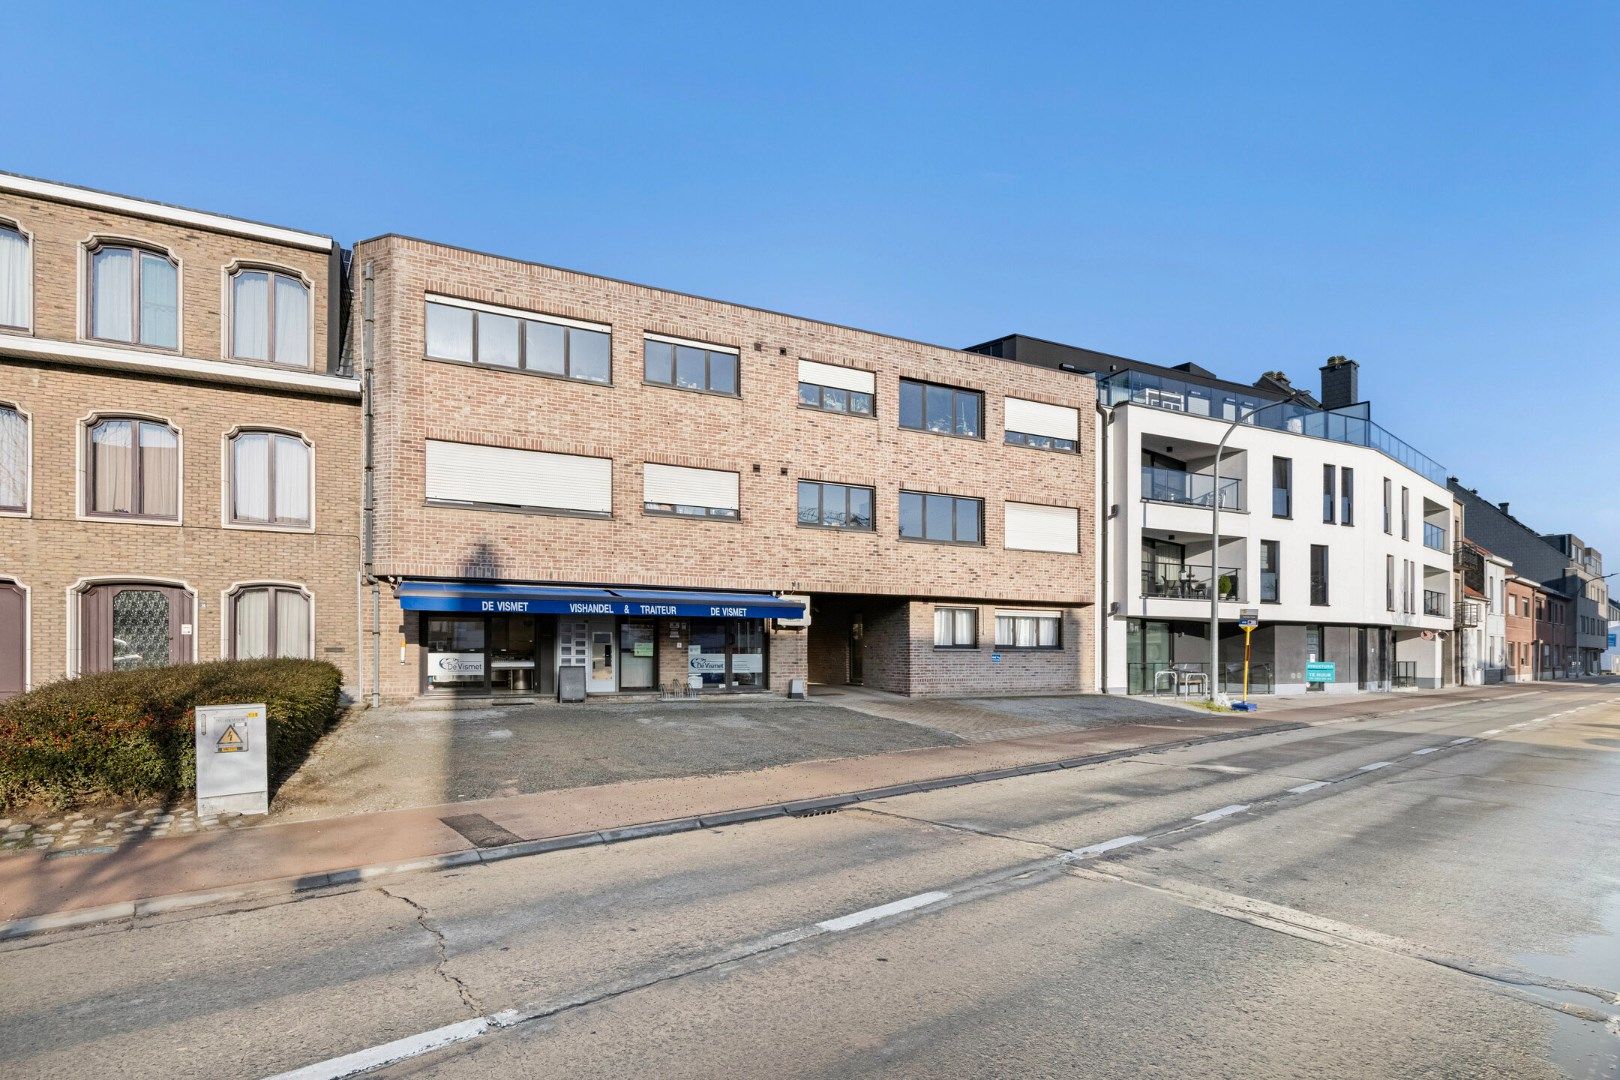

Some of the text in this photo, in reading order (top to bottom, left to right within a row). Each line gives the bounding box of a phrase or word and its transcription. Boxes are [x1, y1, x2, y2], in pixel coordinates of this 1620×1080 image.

[481, 600, 529, 612] DE VISMET
[569, 603, 677, 615] VISHANDEL & TRAITEUR
[710, 607, 747, 617] DE VISMET
[447, 663, 482, 671] De Vismet
